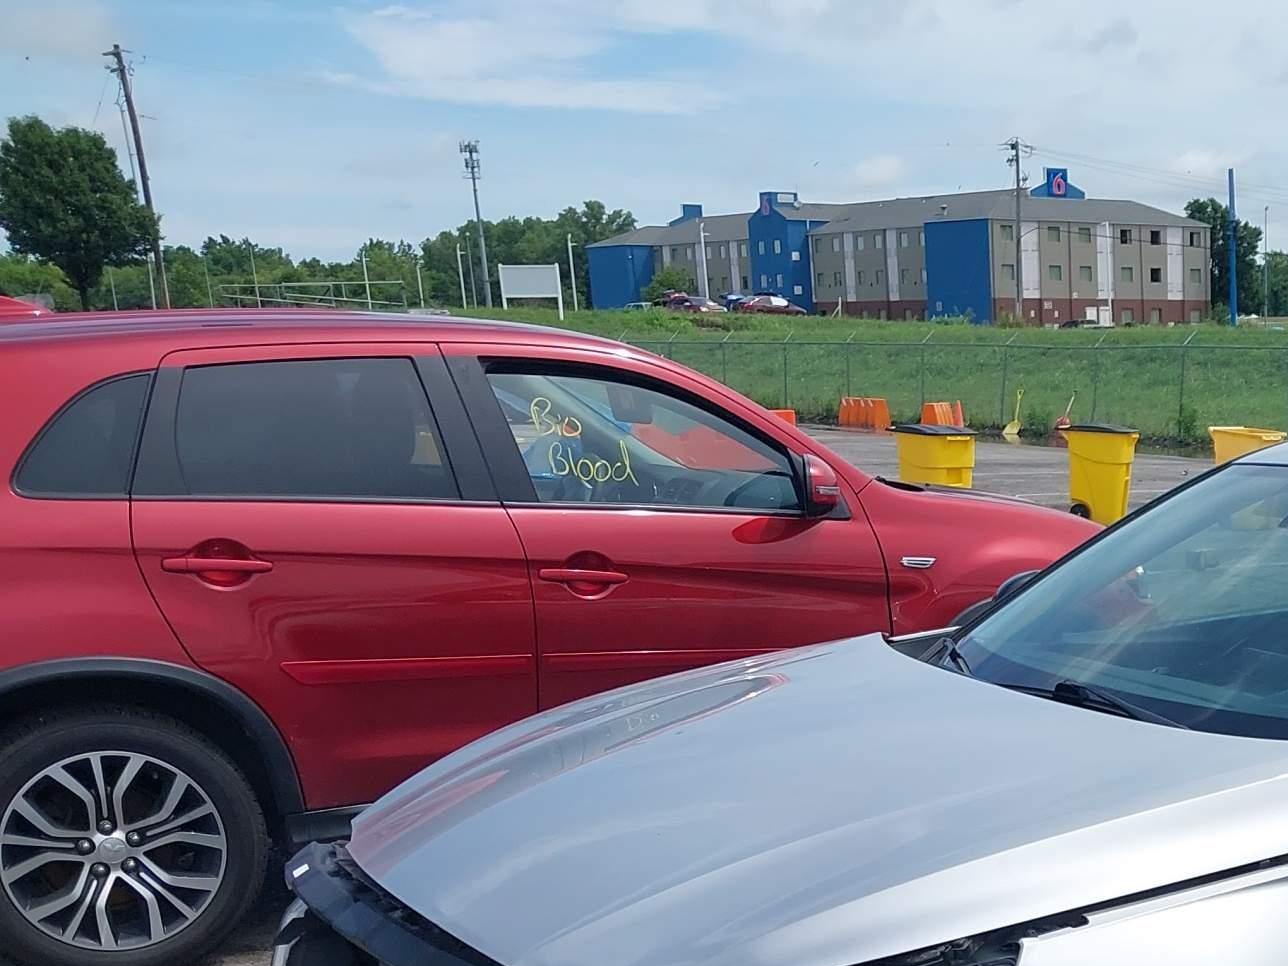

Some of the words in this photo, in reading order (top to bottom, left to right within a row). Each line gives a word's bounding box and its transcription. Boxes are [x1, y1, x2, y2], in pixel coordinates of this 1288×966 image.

[1053, 172, 1066, 195] 6
[530, 397, 582, 437] Bio
[548, 439, 640, 488] Blood
